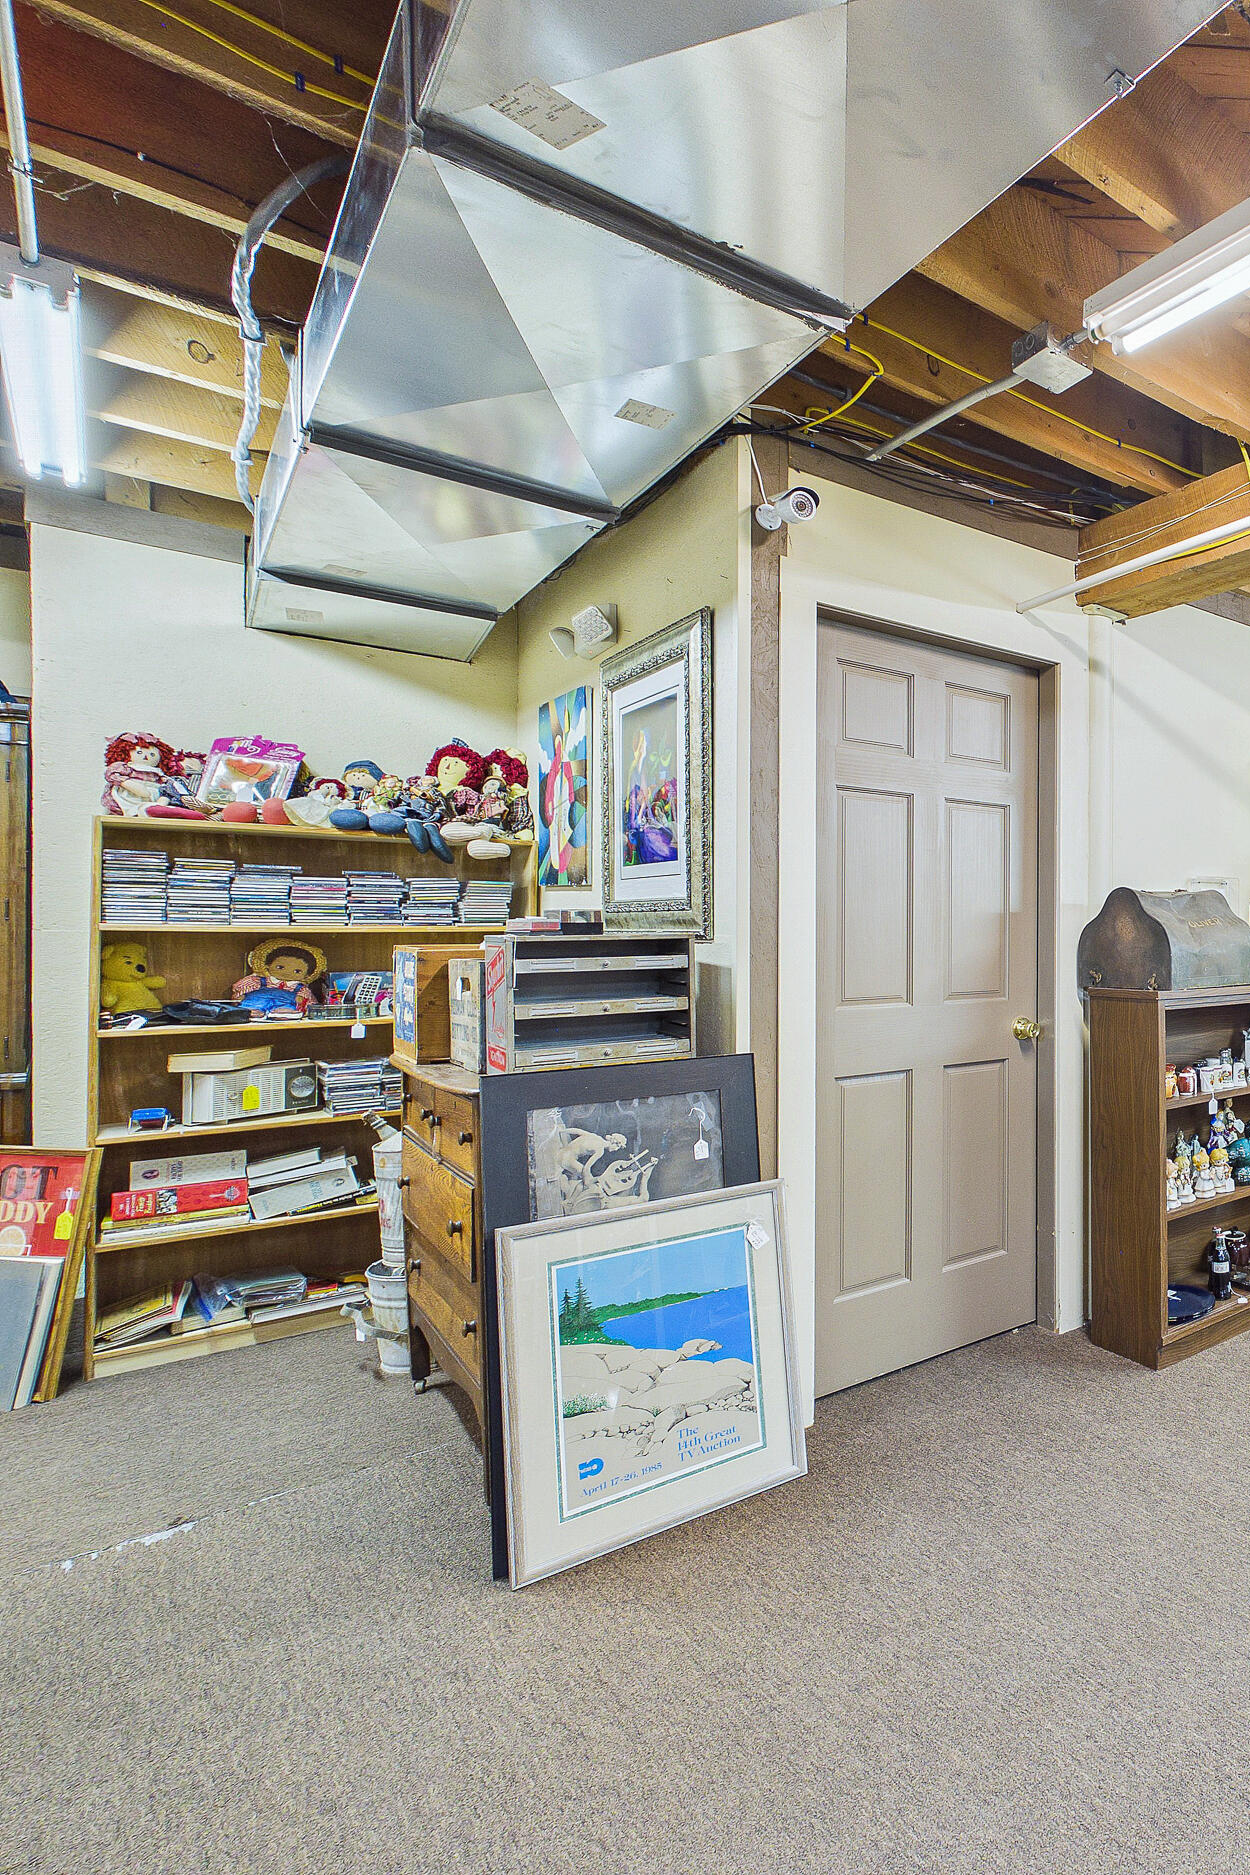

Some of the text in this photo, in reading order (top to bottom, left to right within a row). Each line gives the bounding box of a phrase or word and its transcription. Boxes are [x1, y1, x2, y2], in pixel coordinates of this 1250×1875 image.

[676, 1426, 699, 1439] The
[678, 1425, 736, 1451] 14th Great
[677, 1435, 741, 1462] TV Auction
[580, 1480, 608, 1497] April
